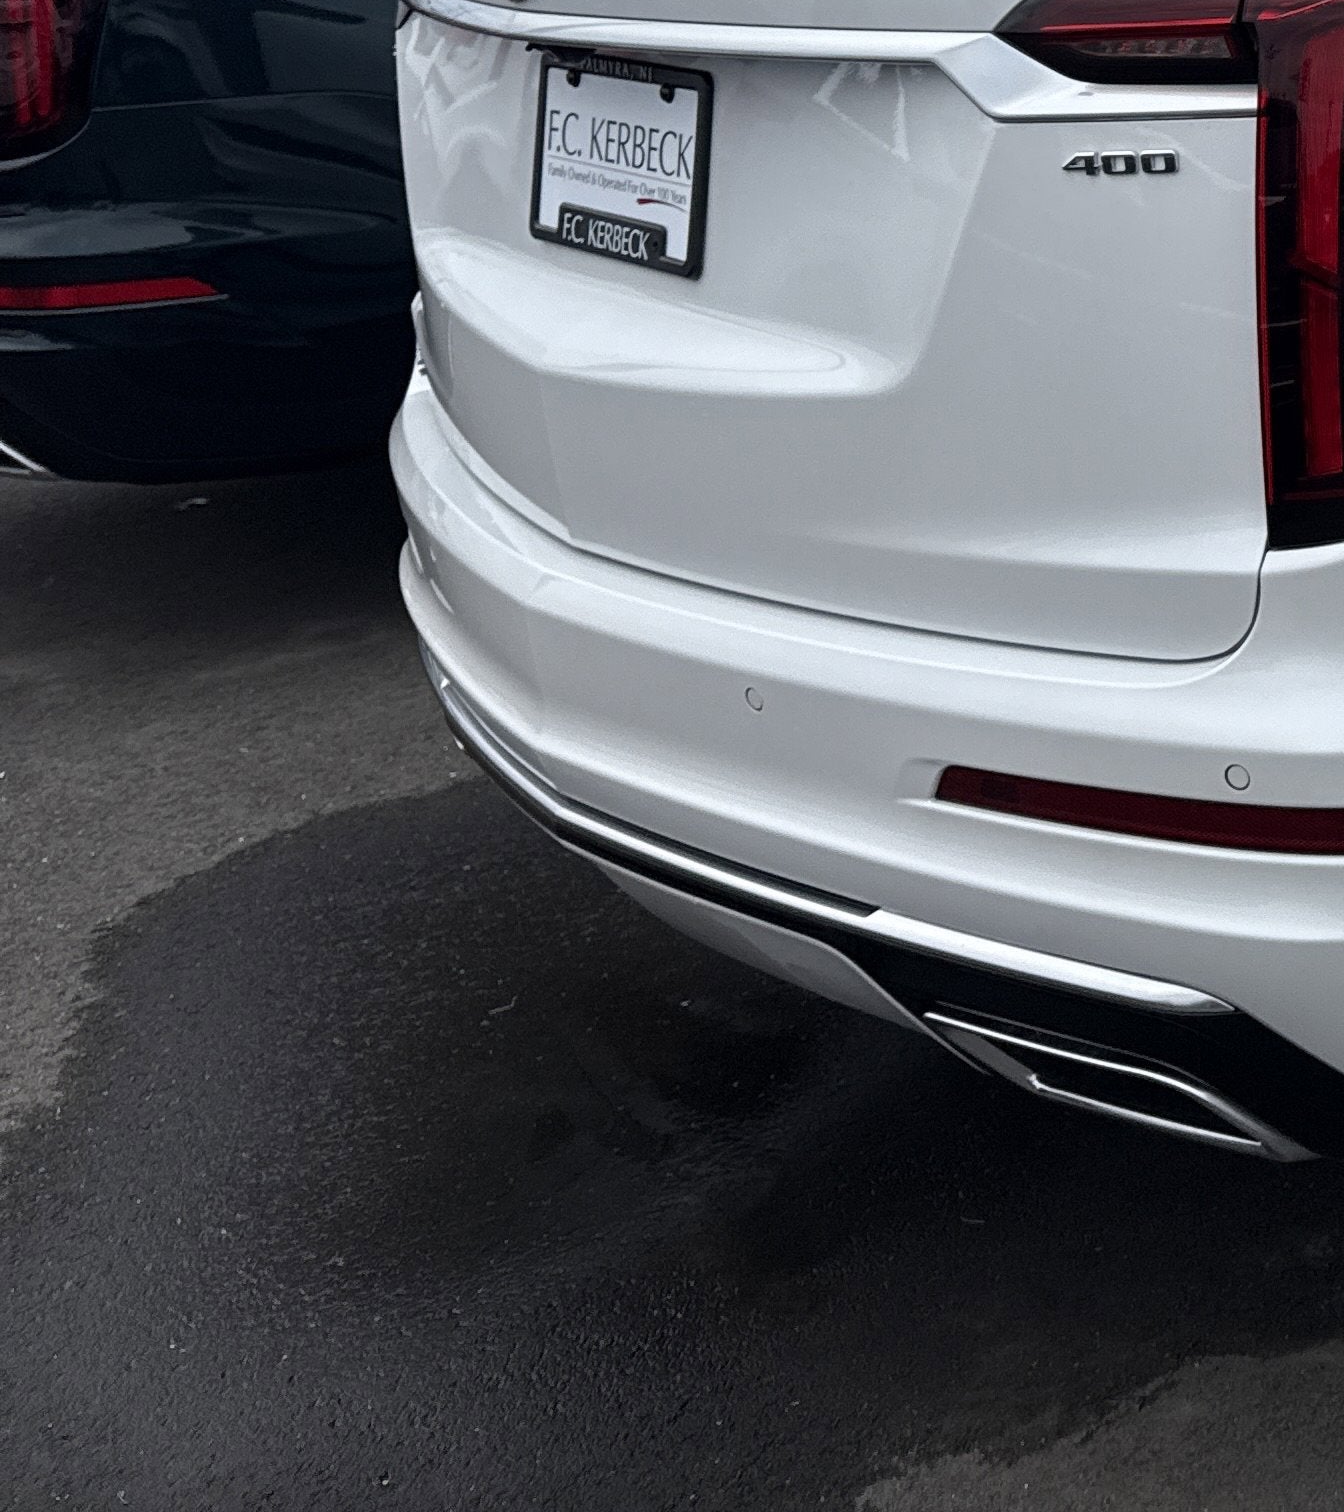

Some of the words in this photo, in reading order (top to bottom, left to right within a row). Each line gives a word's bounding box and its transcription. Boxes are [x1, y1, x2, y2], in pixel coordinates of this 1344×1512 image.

[548, 109, 582, 157] F.C.
[590, 117, 694, 180] KERBECK
[1062, 149, 1180, 176] 400
[562, 212, 585, 244] F.C.
[588, 219, 650, 261] KERBECK
